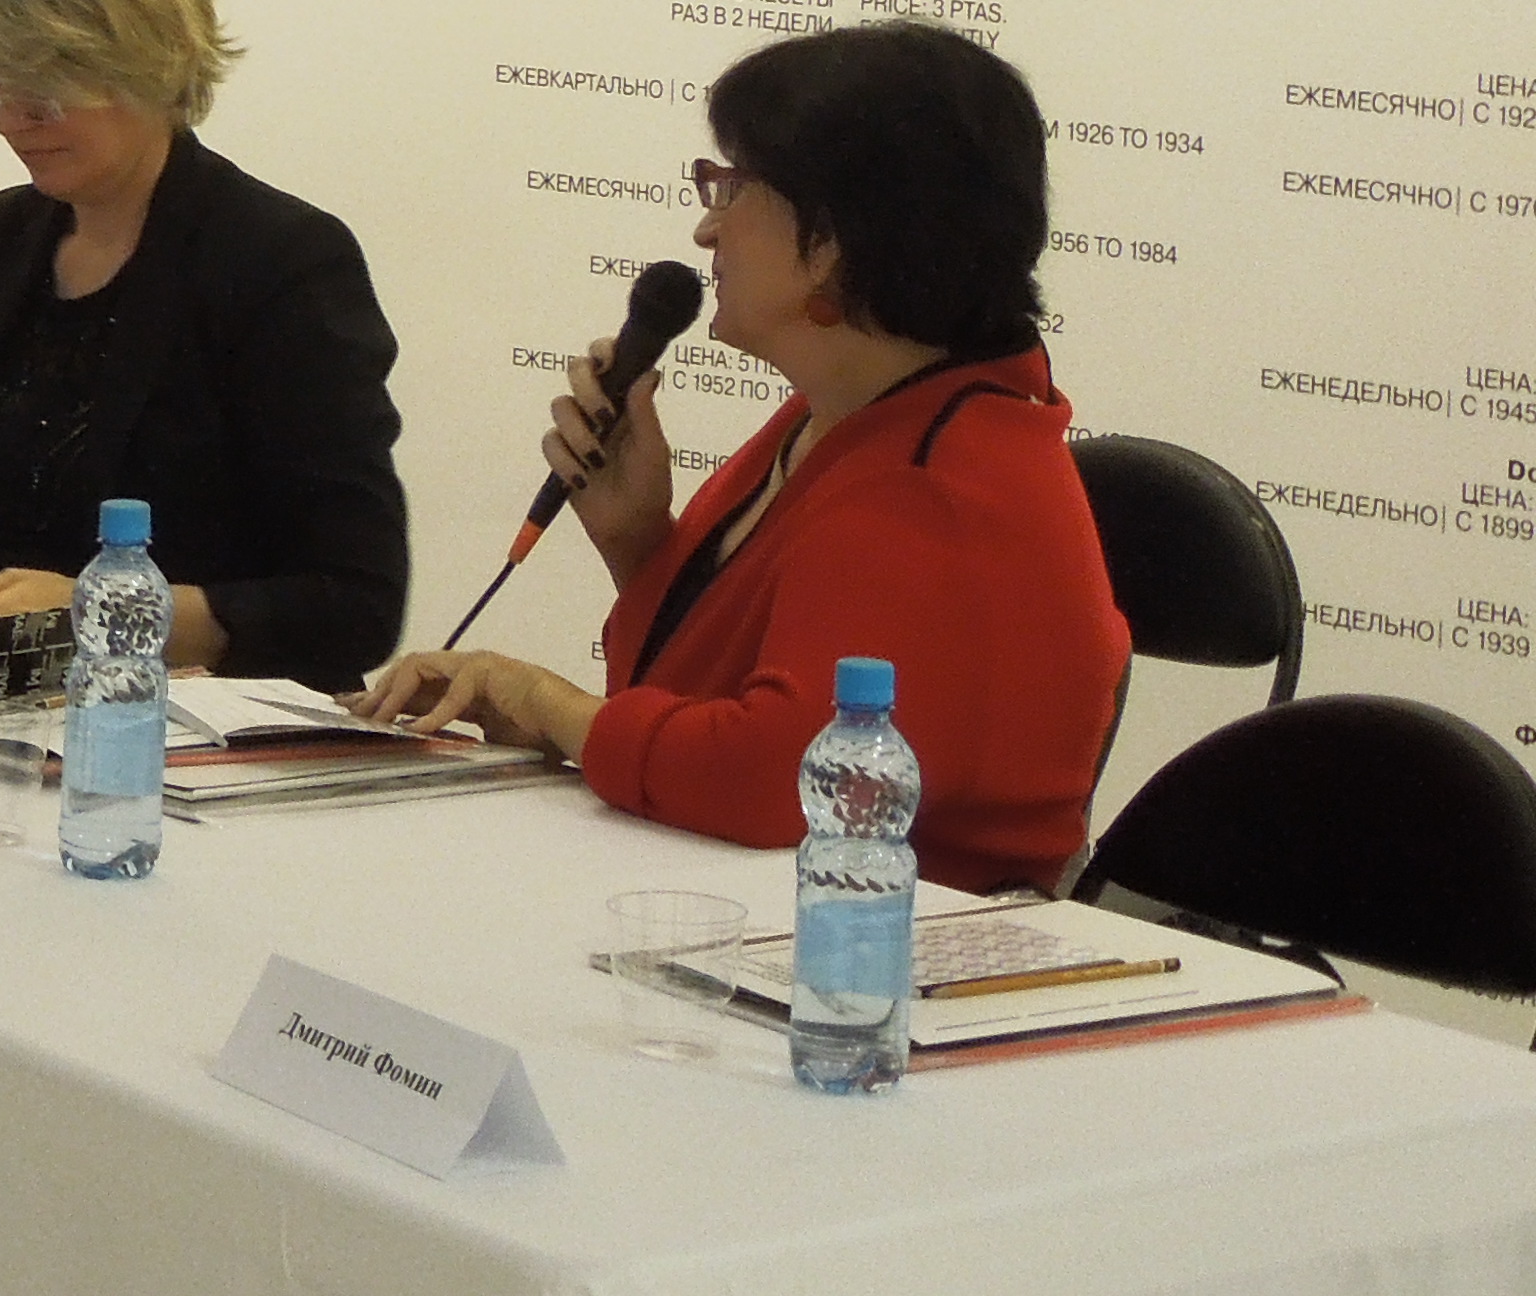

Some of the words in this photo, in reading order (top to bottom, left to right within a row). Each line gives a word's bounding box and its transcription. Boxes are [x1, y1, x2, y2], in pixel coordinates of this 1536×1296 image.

[1481, 513, 1534, 541] 1899
[1457, 597, 1528, 628] ЦЕНА:
[1478, 629, 1530, 658] 1939
[277, 1011, 372, 1068] Дмитрий
[373, 1051, 443, 1100] Фомин
